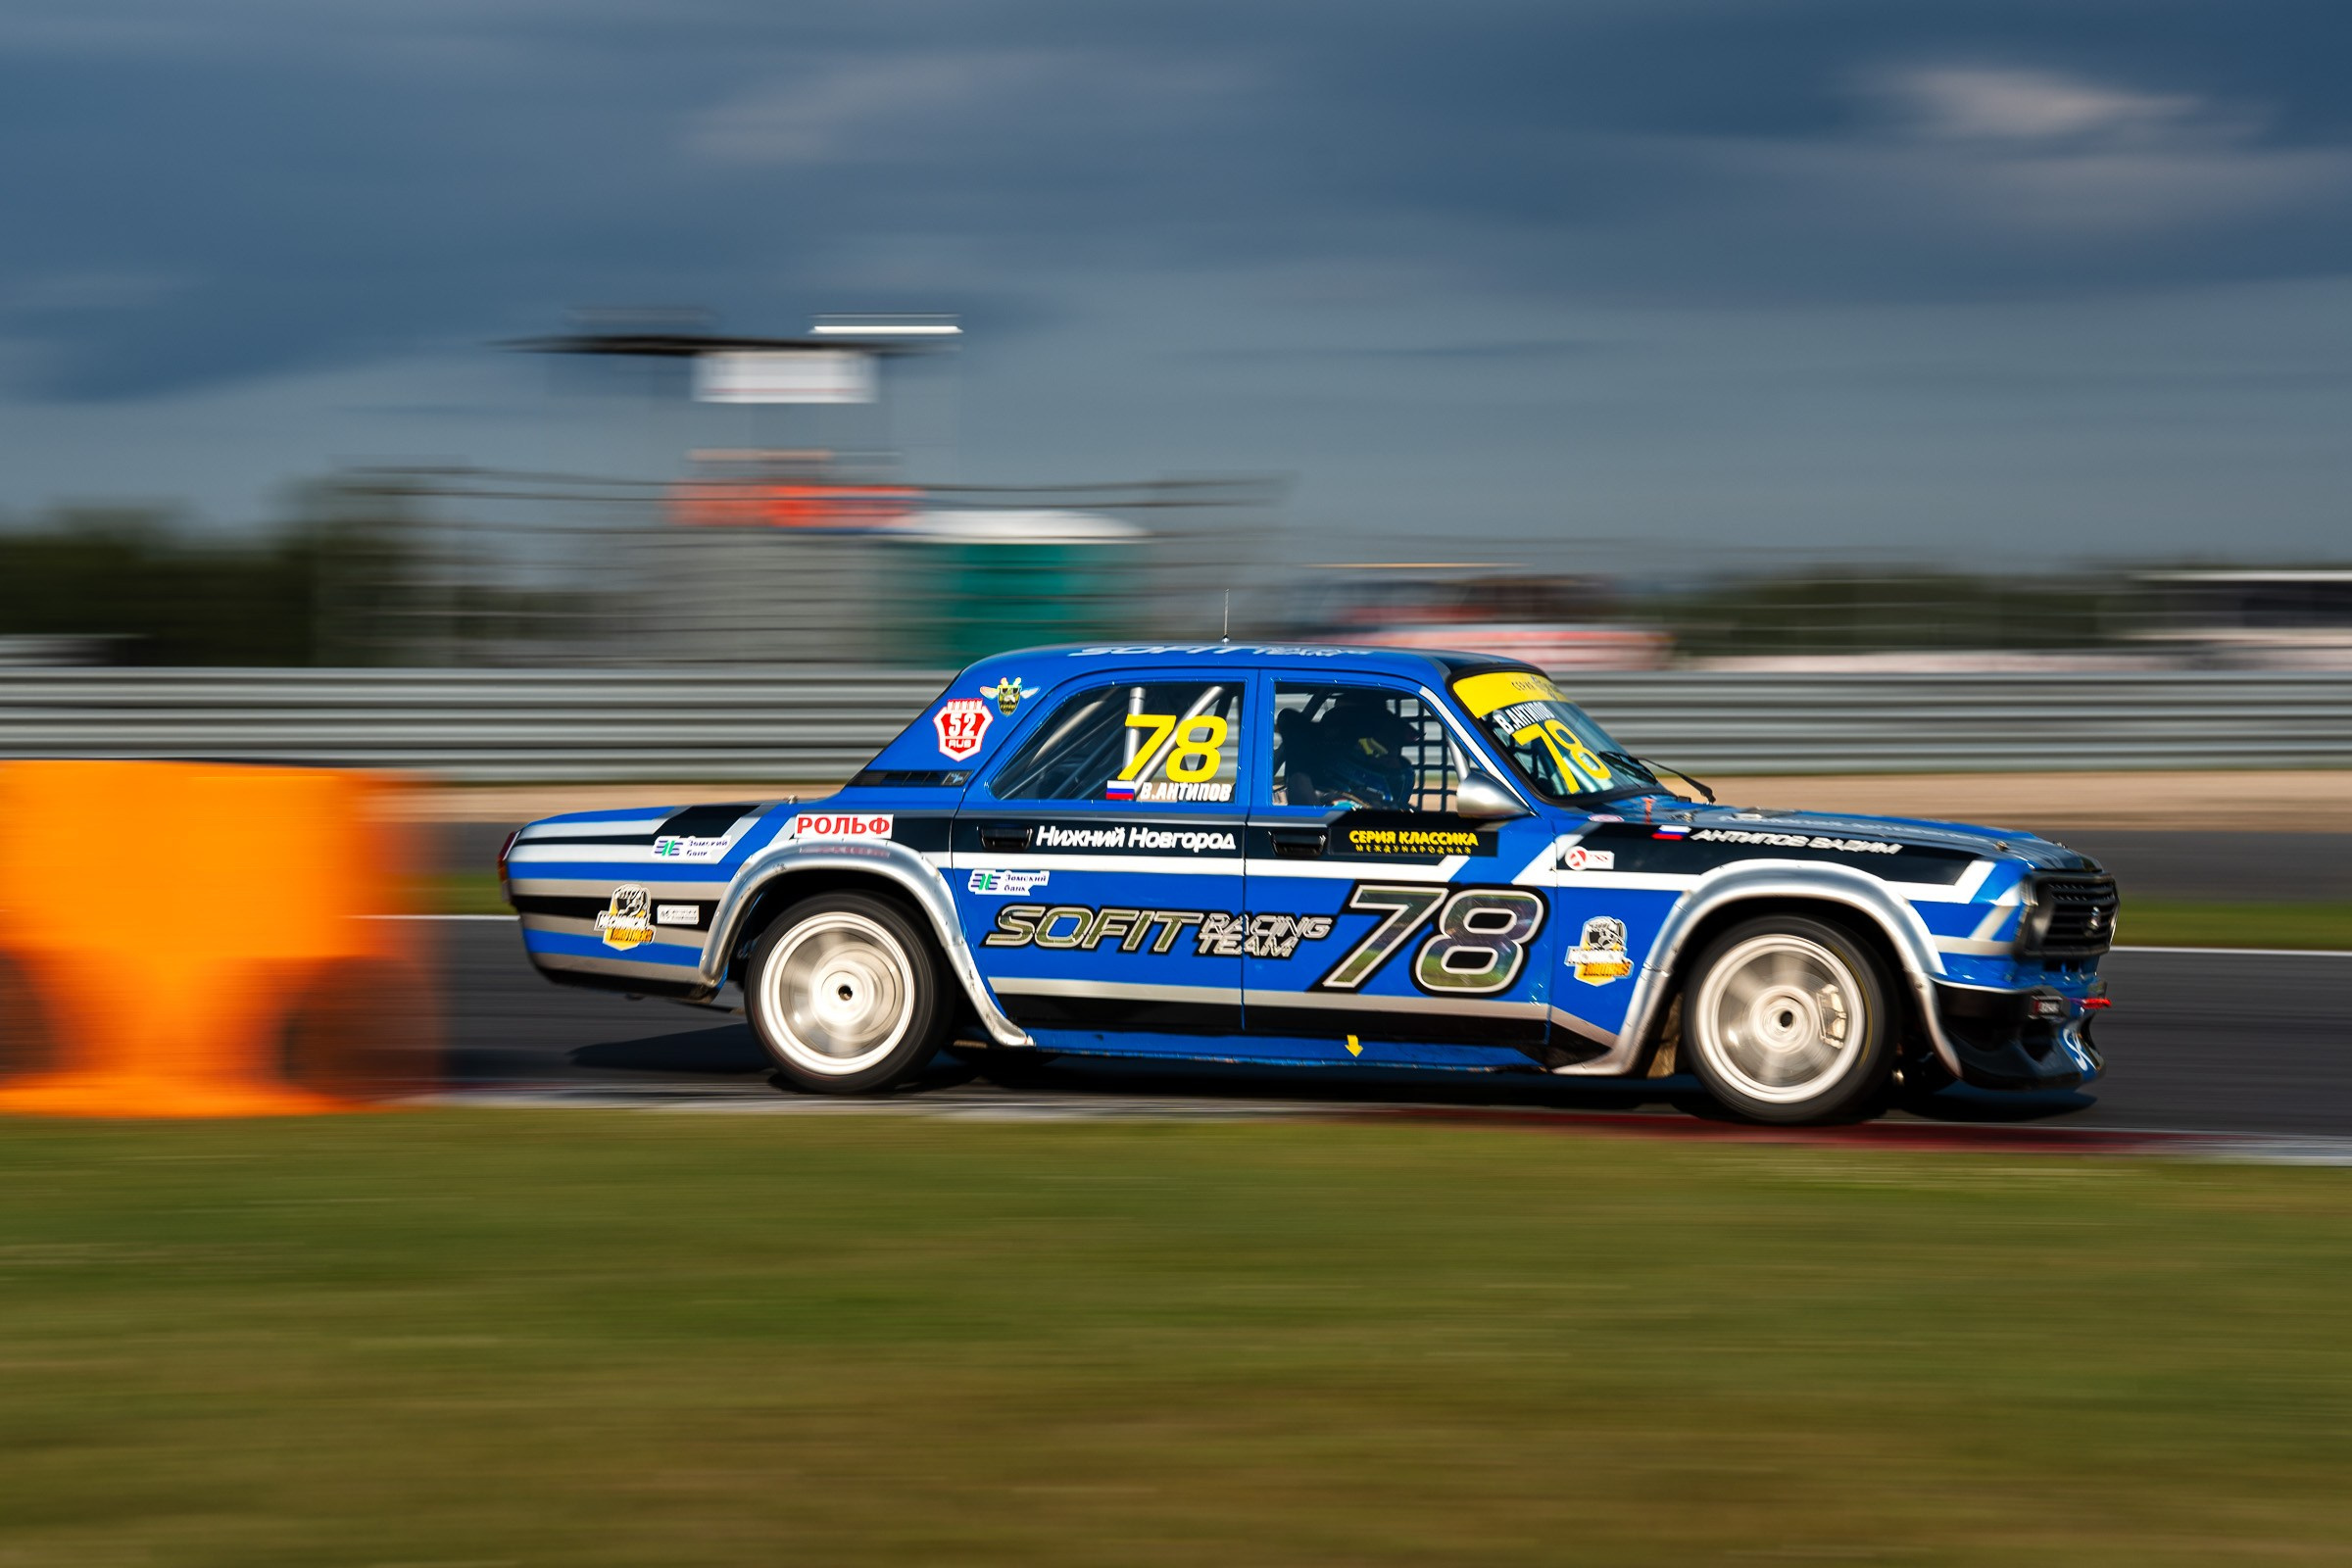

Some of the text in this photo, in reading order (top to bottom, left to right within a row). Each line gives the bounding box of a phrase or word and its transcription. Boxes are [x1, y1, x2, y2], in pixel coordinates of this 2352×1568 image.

[948, 711, 978, 737] 52
[1117, 713, 1228, 783] 78
[1512, 718, 1613, 795] 78
[1140, 781, 1233, 802] В.АНТИПОВ
[797, 816, 890, 835] РОЛЬФ
[1348, 830, 1480, 847] СЕРИЯ КЛАССИКА
[1035, 825, 1237, 854] Нижний Новгород
[1355, 844, 1472, 855] МЕЖДУНАРОДНАЯ
[986, 905, 1333, 953] SOFIT RACING
[1323, 884, 1544, 994] 78
[1197, 934, 1301, 957] TEAM
